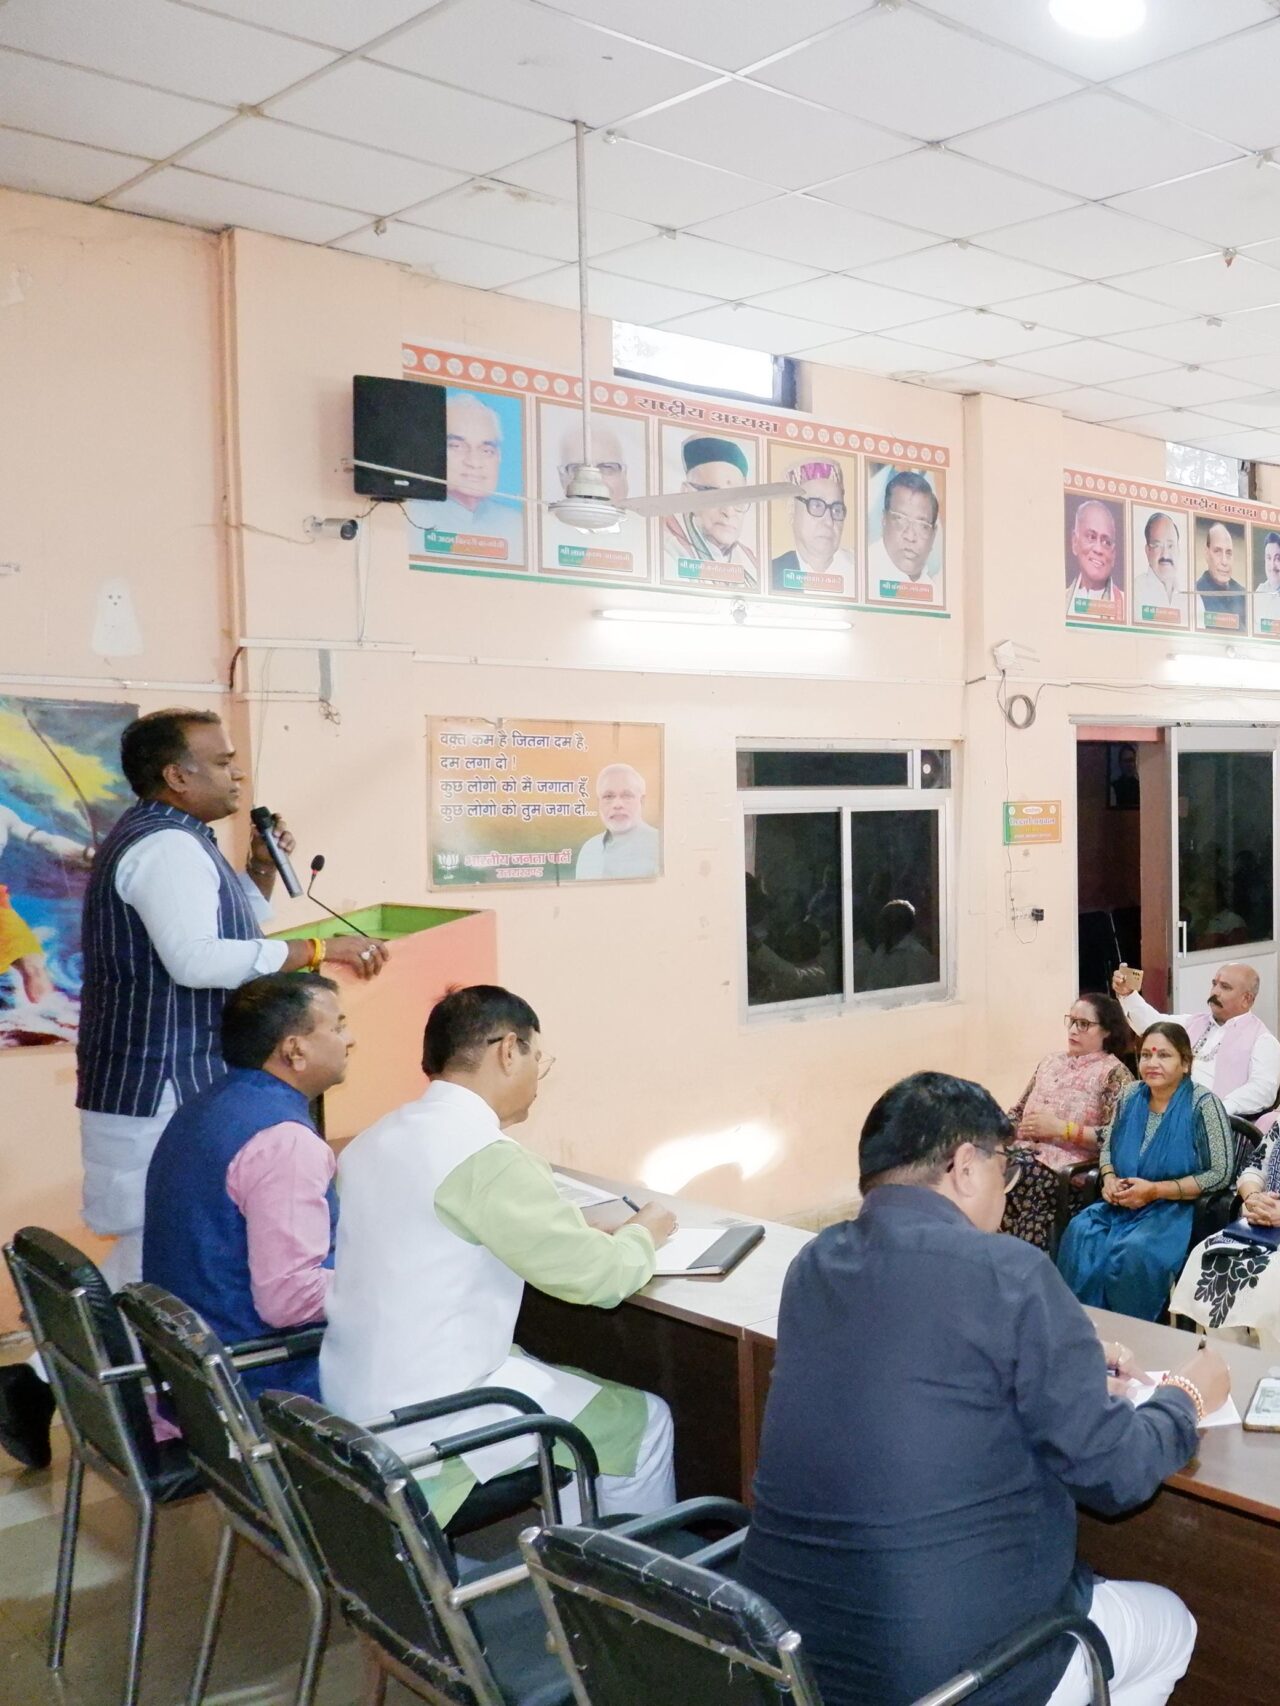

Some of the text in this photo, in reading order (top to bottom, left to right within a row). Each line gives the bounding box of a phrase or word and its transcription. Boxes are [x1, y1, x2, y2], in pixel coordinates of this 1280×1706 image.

[638, 397, 779, 432] राष्ट्रीय अध्यक्ष
[471, 733, 494, 747] कम
[498, 731, 508, 748] है
[512, 731, 550, 748] जितना
[554, 736, 572, 748] दम
[440, 756, 460, 769] दम
[464, 756, 491, 769] लगा
[495, 753, 508, 769] दो
[440, 780, 464, 798] कुछ
[501, 776, 517, 793] को
[537, 780, 575, 793] जगाता
[440, 804, 464, 822] कुछ
[501, 800, 517, 816] को
[521, 803, 542, 821] तुम
[545, 804, 571, 816] जगा
